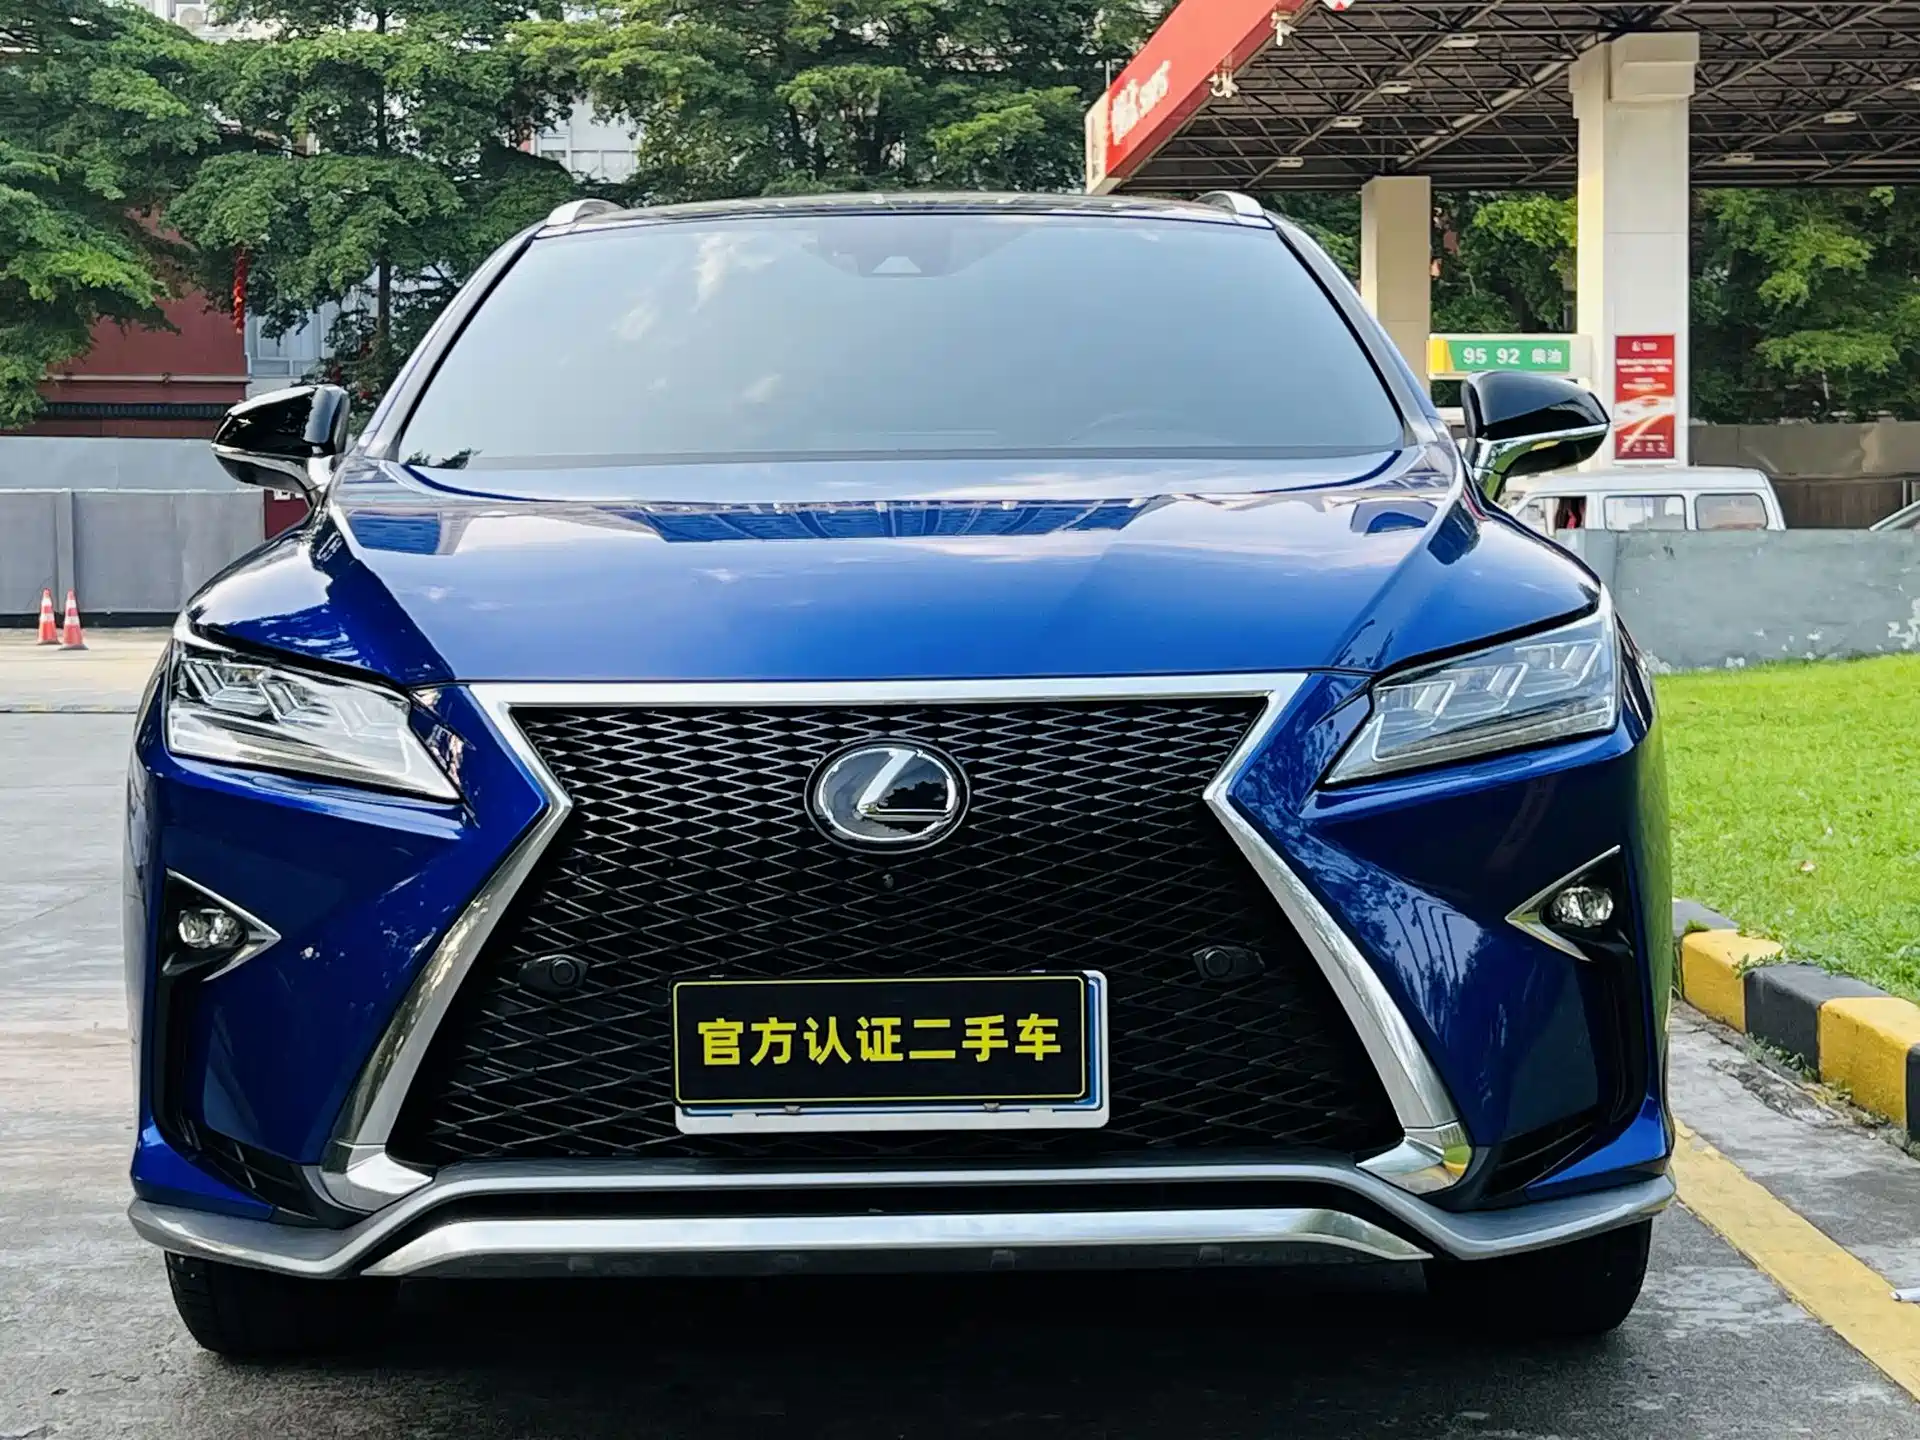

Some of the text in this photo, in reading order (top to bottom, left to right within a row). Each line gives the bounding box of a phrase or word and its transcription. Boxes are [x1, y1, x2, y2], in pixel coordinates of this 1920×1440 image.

[1463, 347, 1487, 364] 95
[1496, 347, 1520, 364] 92
[698, 1013, 1061, 1066] 官方认证二手车
